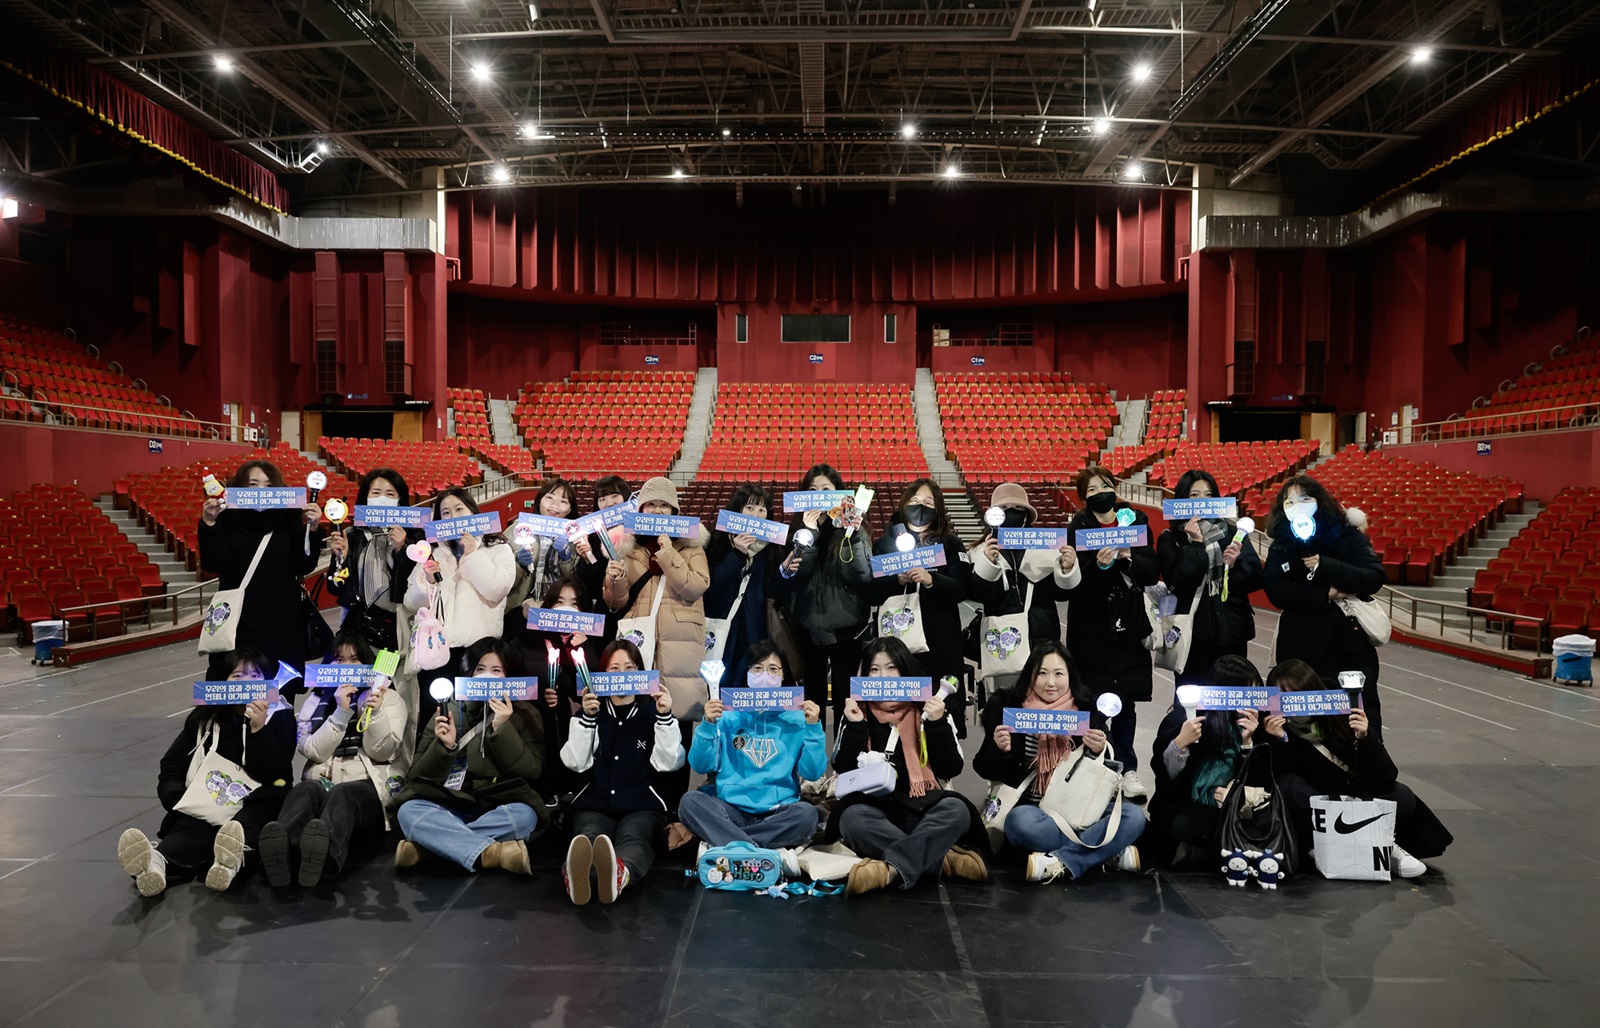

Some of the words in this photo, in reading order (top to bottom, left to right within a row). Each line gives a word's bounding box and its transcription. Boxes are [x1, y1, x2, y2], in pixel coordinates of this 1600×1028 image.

[435, 522, 454, 530] 우리의
[470, 516, 489, 526] 추억이
[728, 515, 747, 524] 우리의
[748, 519, 760, 528] 꿈과
[762, 522, 779, 532] 추억이
[436, 530, 455, 538] 언제나
[727, 522, 745, 531] 언제나
[765, 531, 778, 539] 있어
[881, 555, 900, 564] 우리의
[901, 553, 914, 561] 꿈과
[916, 550, 934, 559] 추억이
[882, 562, 901, 572] 언제나
[903, 559, 921, 569] 여기에
[923, 556, 935, 565] 있어
[539, 612, 558, 621] 우리의
[560, 613, 573, 622] 꿈과
[575, 614, 594, 624] 추억이
[538, 619, 557, 628] 언제나
[559, 621, 578, 629] 여기에
[580, 622, 593, 631] 있어
[489, 681, 503, 689] 꿈과
[505, 681, 526, 689] 추억이
[466, 689, 488, 697] 언제나
[771, 690, 792, 699] 추억이
[732, 699, 754, 707] 언제나
[778, 699, 792, 707] 있어
[1334, 701, 1350, 710] 있어
[1056, 714, 1077, 722] 추억이
[1039, 722, 1060, 730] 여기에
